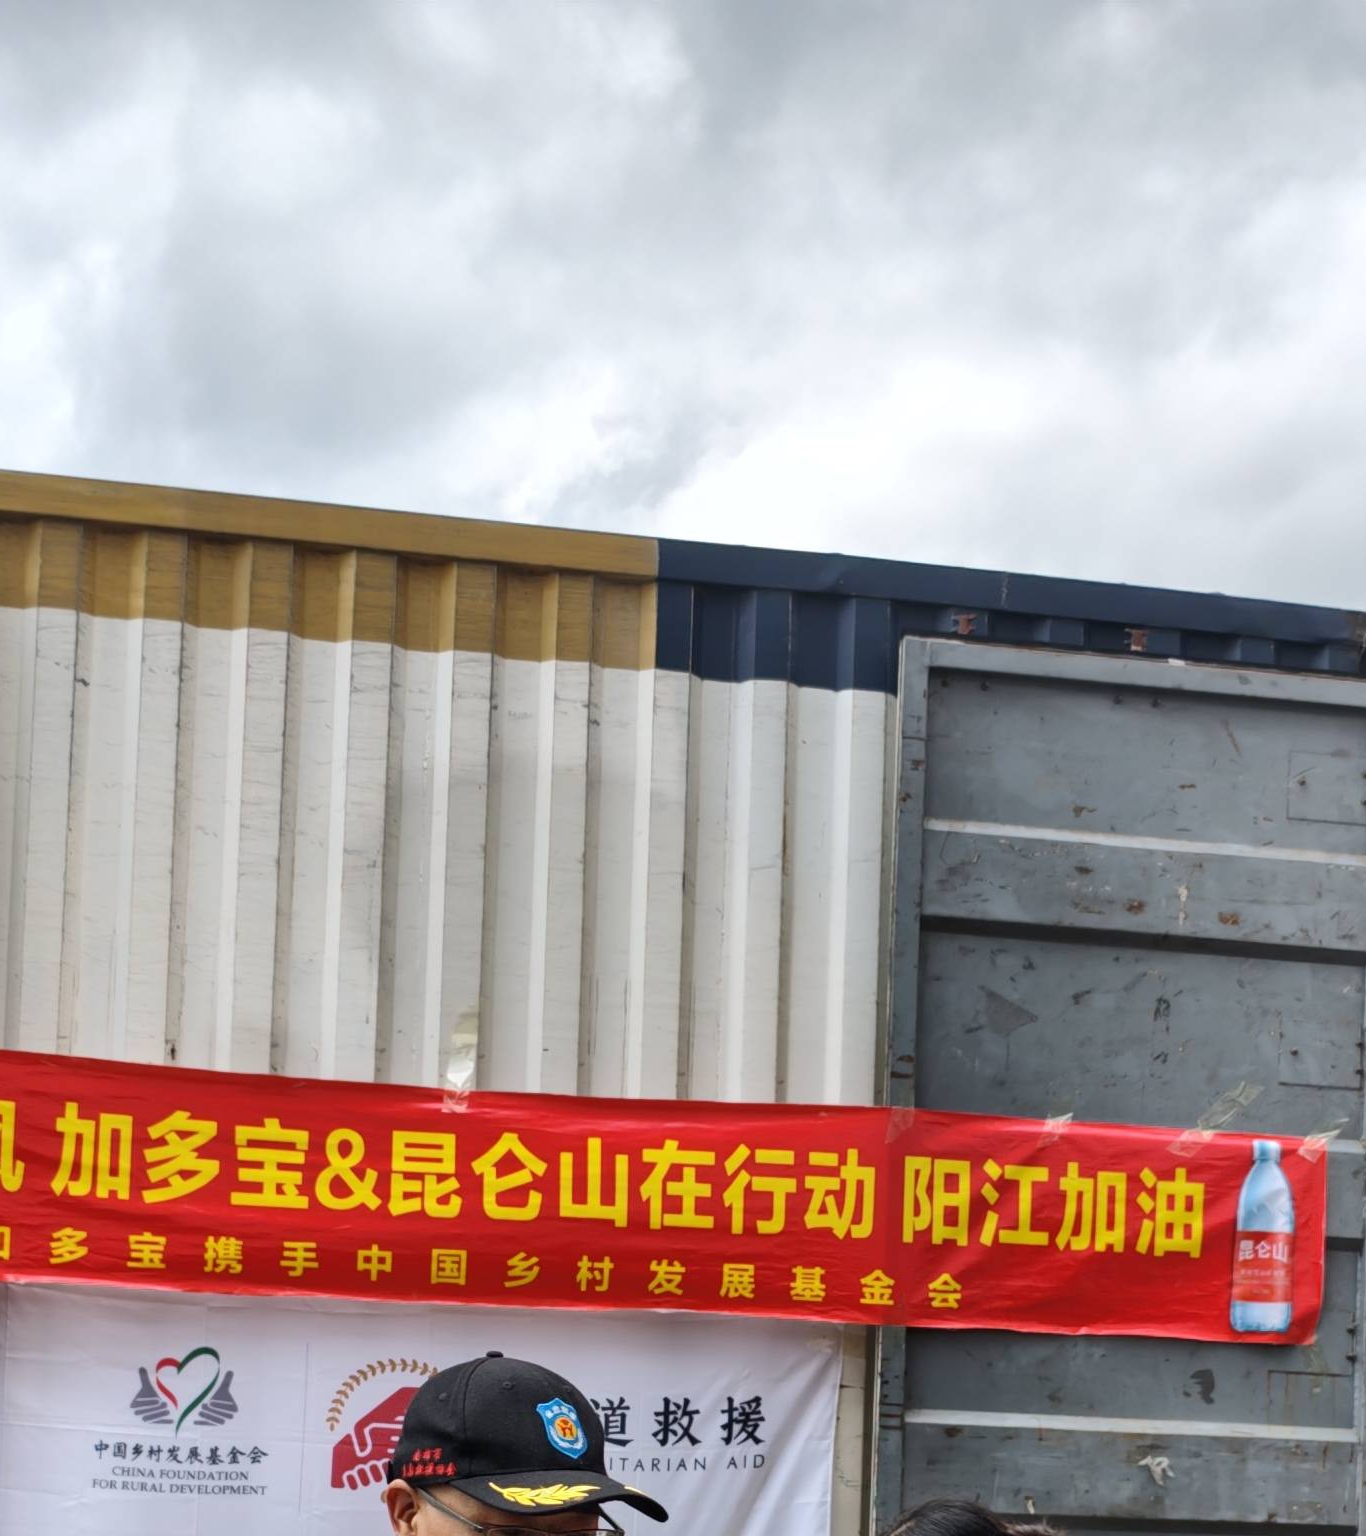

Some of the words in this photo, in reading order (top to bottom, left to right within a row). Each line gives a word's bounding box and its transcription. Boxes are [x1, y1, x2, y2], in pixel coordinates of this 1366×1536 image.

[51, 1101, 876, 1239] 加多宝&昆仑山在行动
[901, 1155, 1206, 1259] 阳江加油
[1238, 1239, 1289, 1264] 昆仑山
[94, 1439, 269, 1465] 中国乡村发展基金会
[726, 1453, 766, 1469] AID
[112, 1466, 156, 1479] CHINA
[159, 1469, 249, 1481] FOUNDATION
[92, 1479, 117, 1490] FOR
[121, 1481, 166, 1493] RURAL
[169, 1483, 268, 1496] DEVELOPMENT
